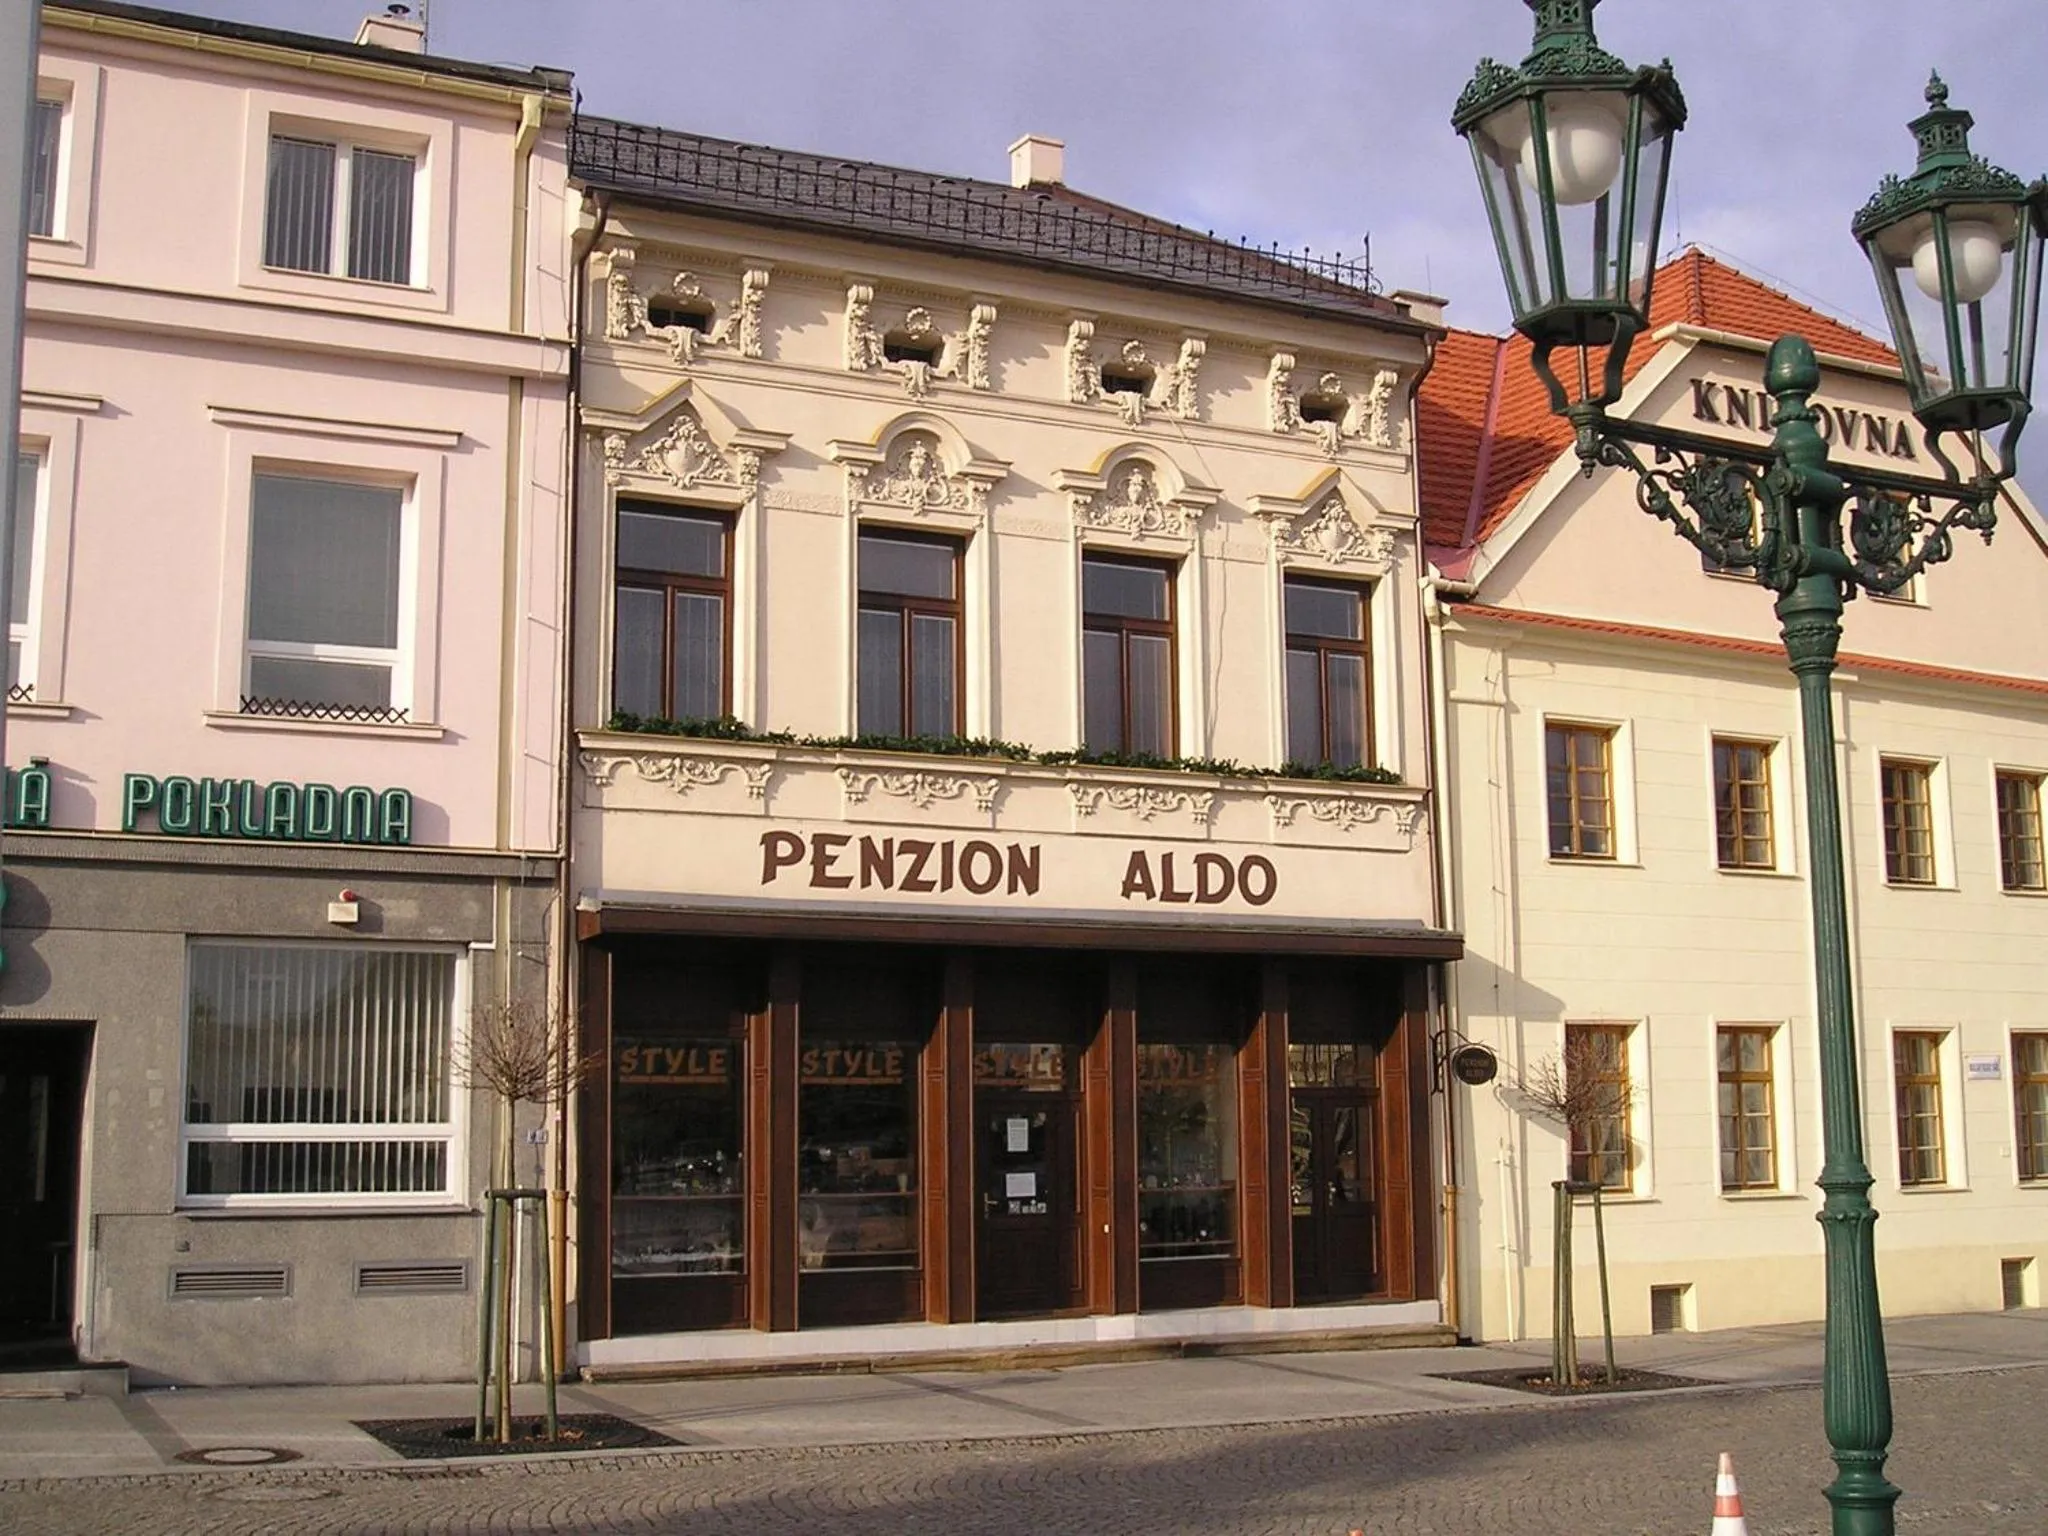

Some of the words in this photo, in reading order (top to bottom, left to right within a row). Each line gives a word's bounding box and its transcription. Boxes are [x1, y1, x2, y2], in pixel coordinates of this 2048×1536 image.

[1690, 378, 1916, 458] KNIOVNA
[123, 772, 412, 844] POKLADNA
[760, 830, 1041, 897] PENZION
[1120, 850, 1277, 906] ALDO
[620, 1047, 728, 1075] STYLE
[801, 1046, 904, 1075] STYLE
[974, 1050, 1064, 1077] STYLE
